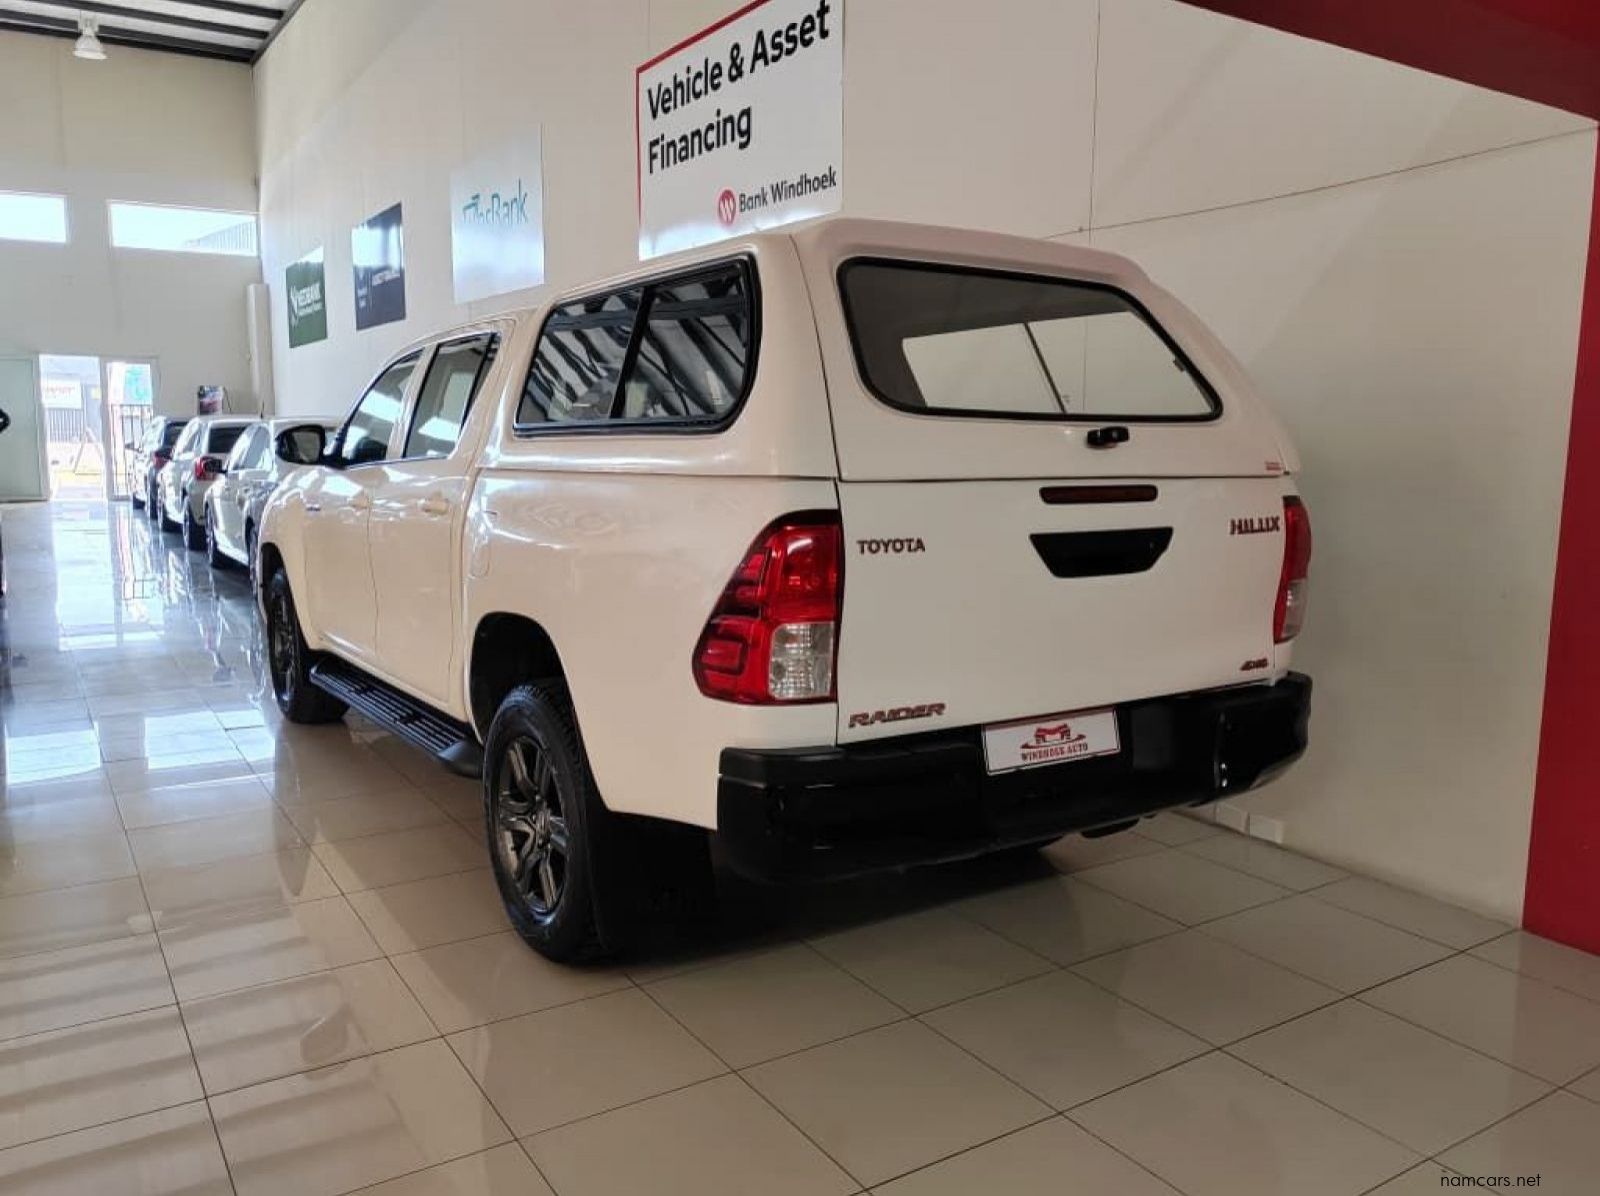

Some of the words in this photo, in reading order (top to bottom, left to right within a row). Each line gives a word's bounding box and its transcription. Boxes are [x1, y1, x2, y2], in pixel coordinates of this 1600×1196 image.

[648, 56, 723, 121] Vehicle
[728, 42, 744, 83] &
[750, 0, 830, 73] Asset
[648, 105, 751, 174] Financing
[739, 186, 768, 213] Bank
[770, 164, 837, 204] Windhoek
[1229, 515, 1280, 535] HILUX
[856, 537, 926, 555] TOYOTA
[848, 702, 946, 729] RAIDER
